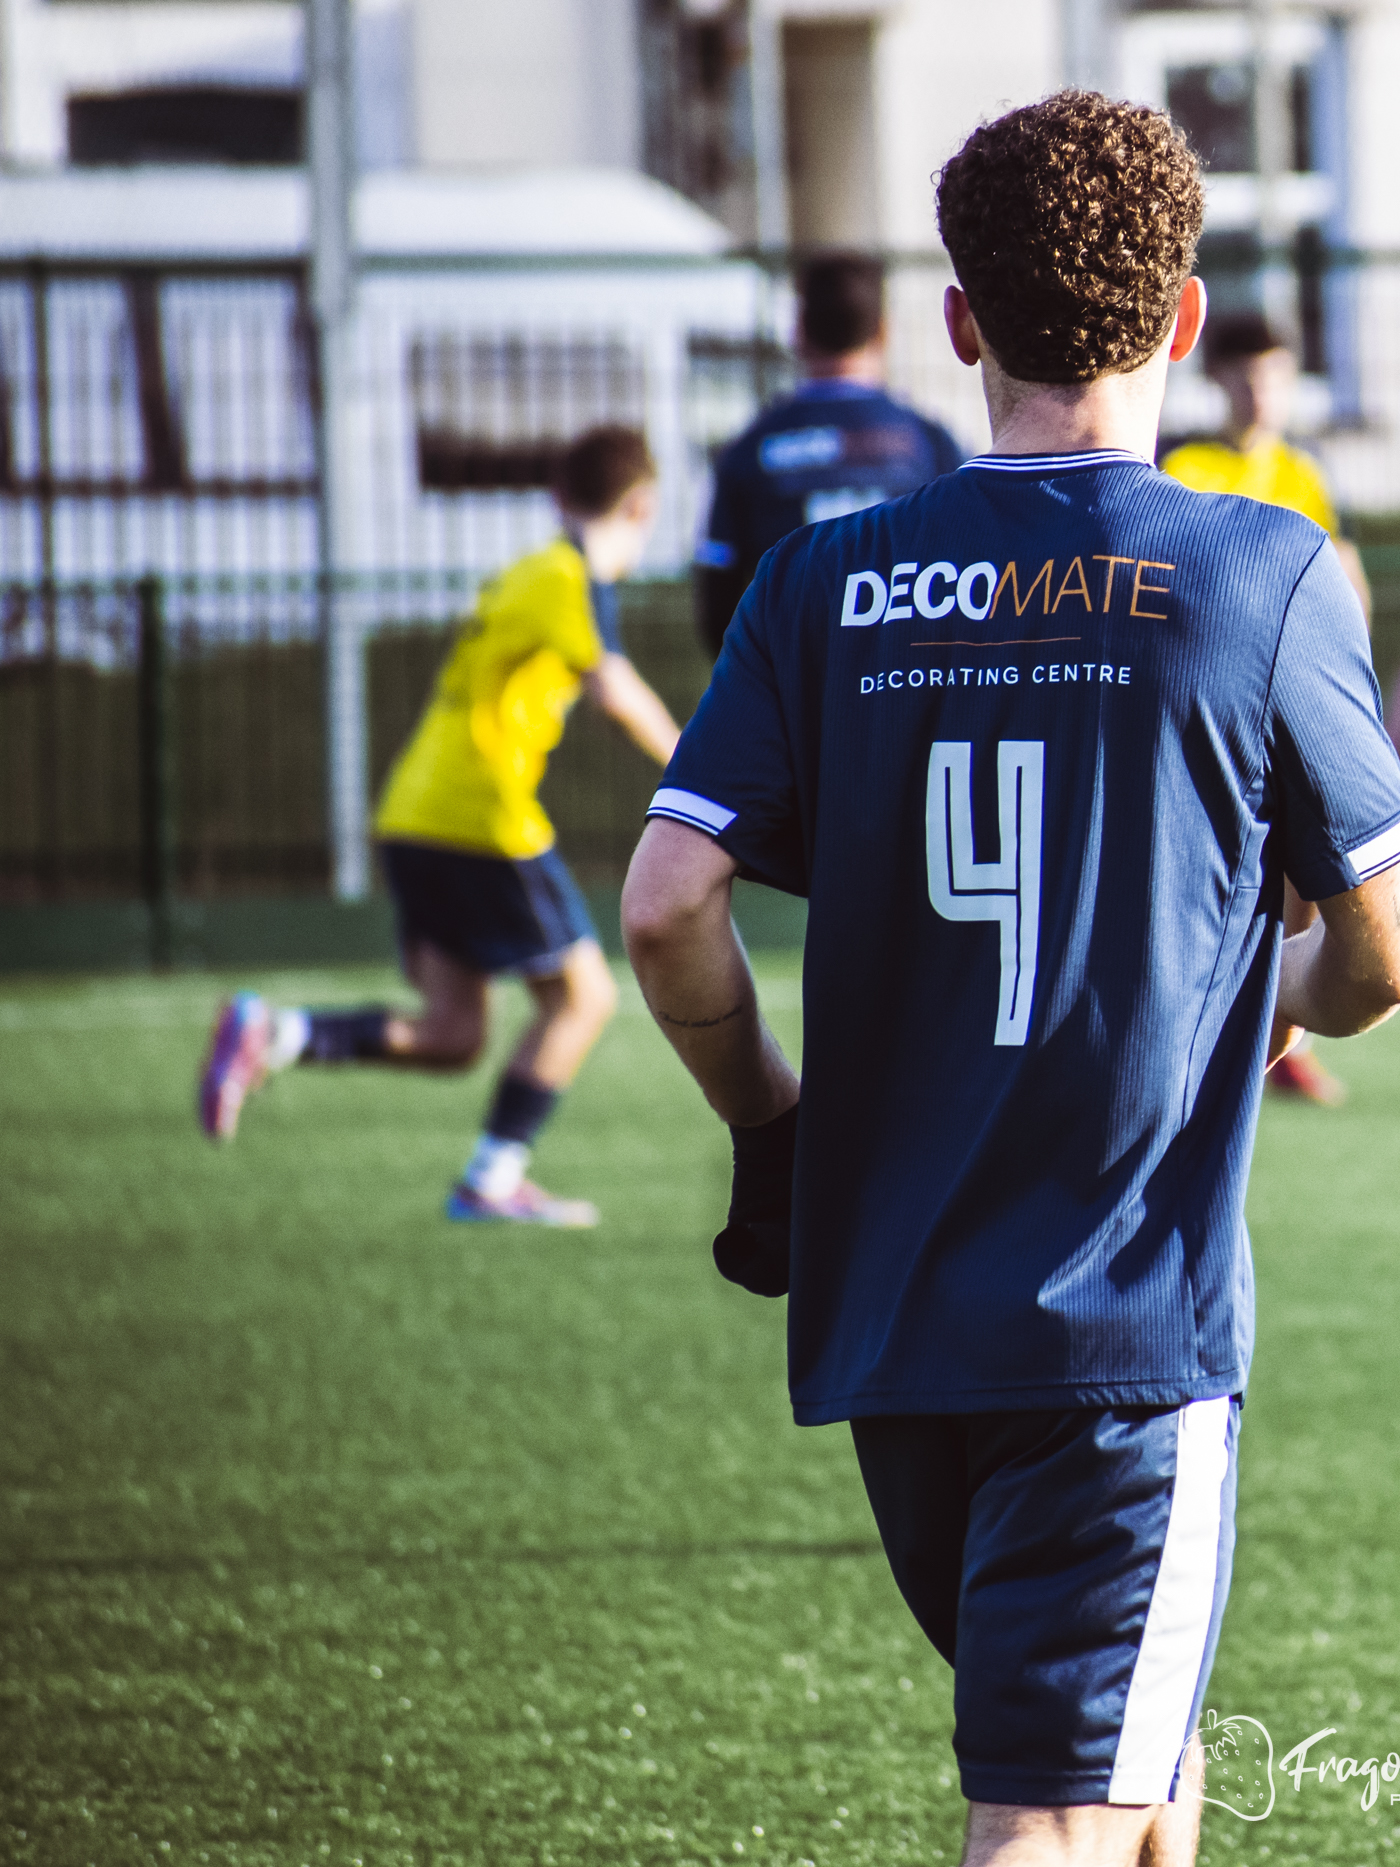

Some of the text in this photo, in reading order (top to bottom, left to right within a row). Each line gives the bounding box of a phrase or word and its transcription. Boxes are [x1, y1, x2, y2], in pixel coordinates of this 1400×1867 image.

[840, 555, 1176, 627] DECOMATE
[859, 663, 1132, 694] DECORATING CENTRE
[925, 740, 1044, 1046] 4
